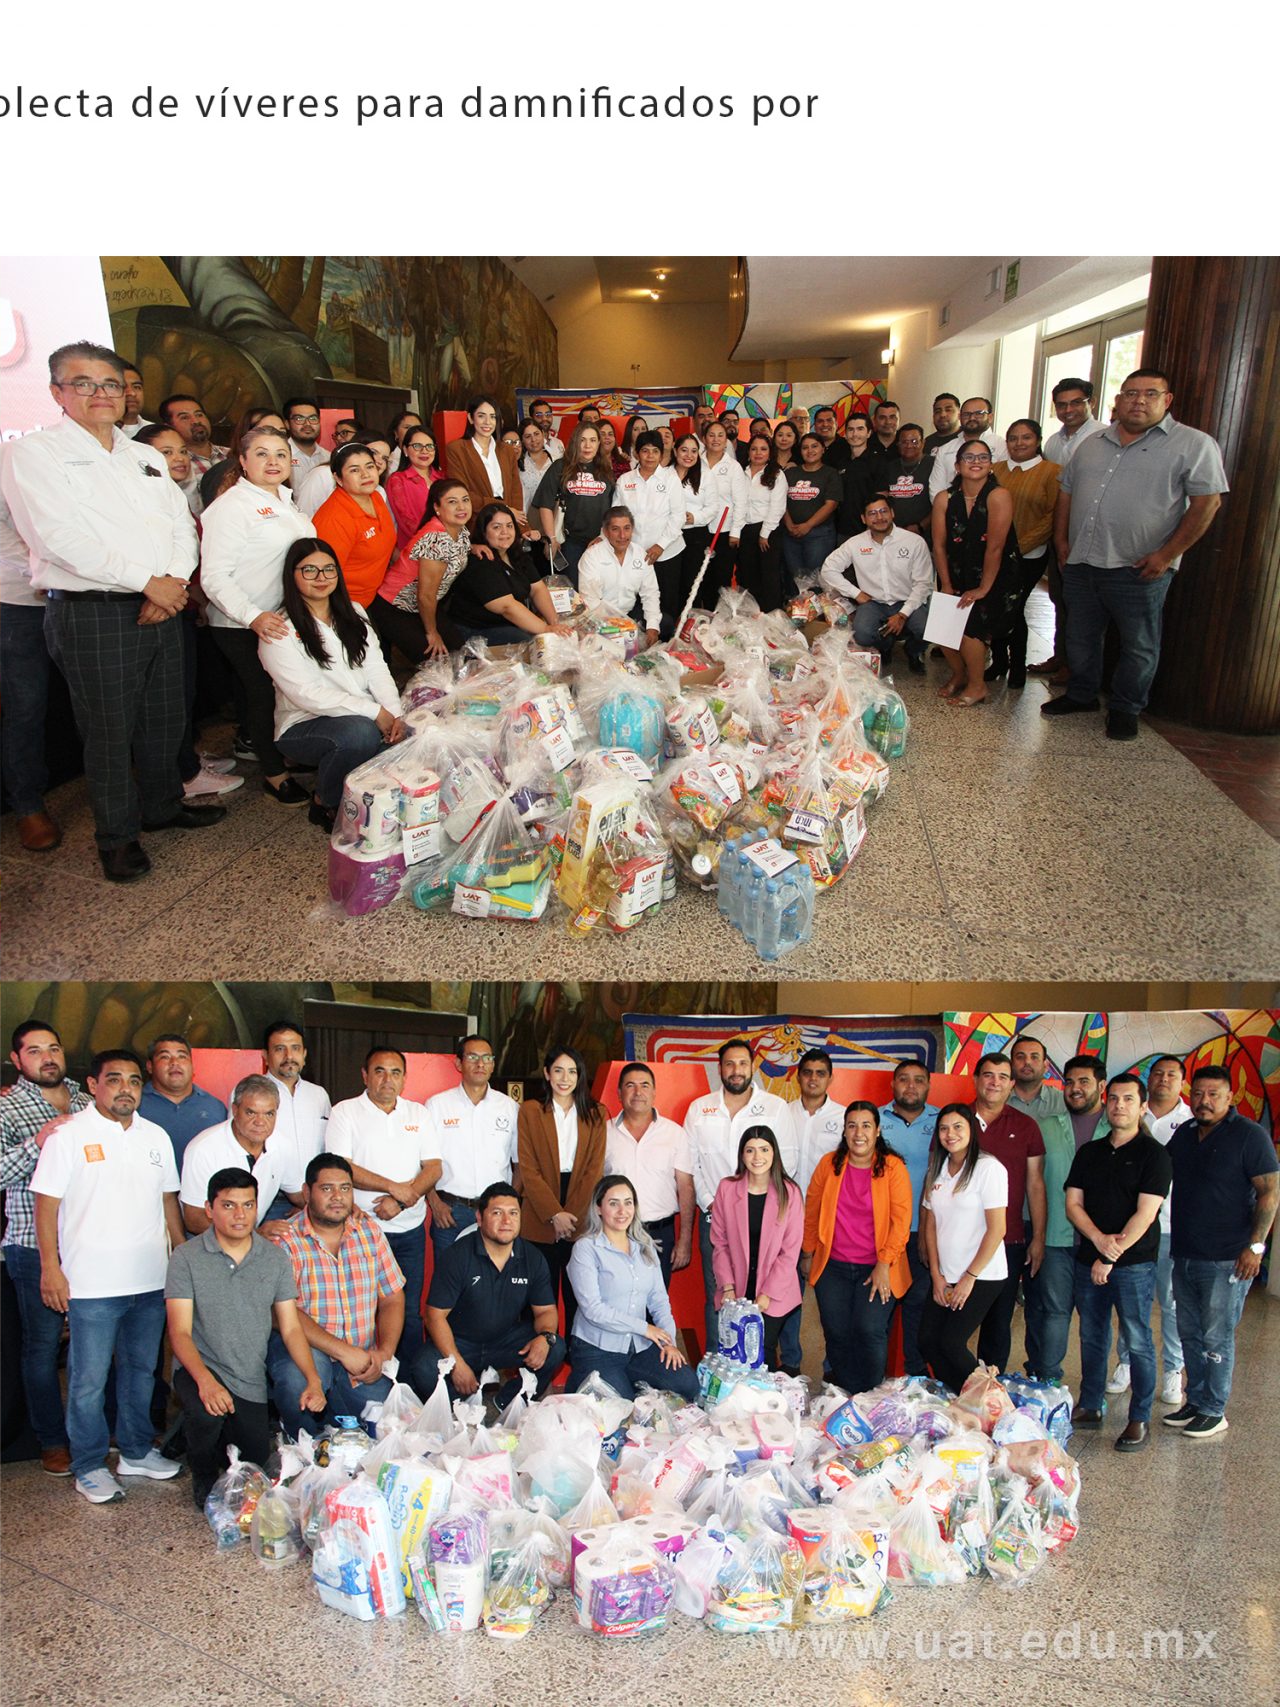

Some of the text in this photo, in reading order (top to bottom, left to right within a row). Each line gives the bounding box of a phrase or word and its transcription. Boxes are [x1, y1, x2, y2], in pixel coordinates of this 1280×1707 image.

[256, 506, 274, 516] UAT
[717, 767, 727, 777] UAT
[412, 828, 431, 839] UAT
[753, 843, 769, 853] UAT
[642, 871, 656, 883] UAT
[462, 893, 482, 902] UAT
[443, 1118, 460, 1126] UAT
[606, 1621, 640, 1633] Colgate
